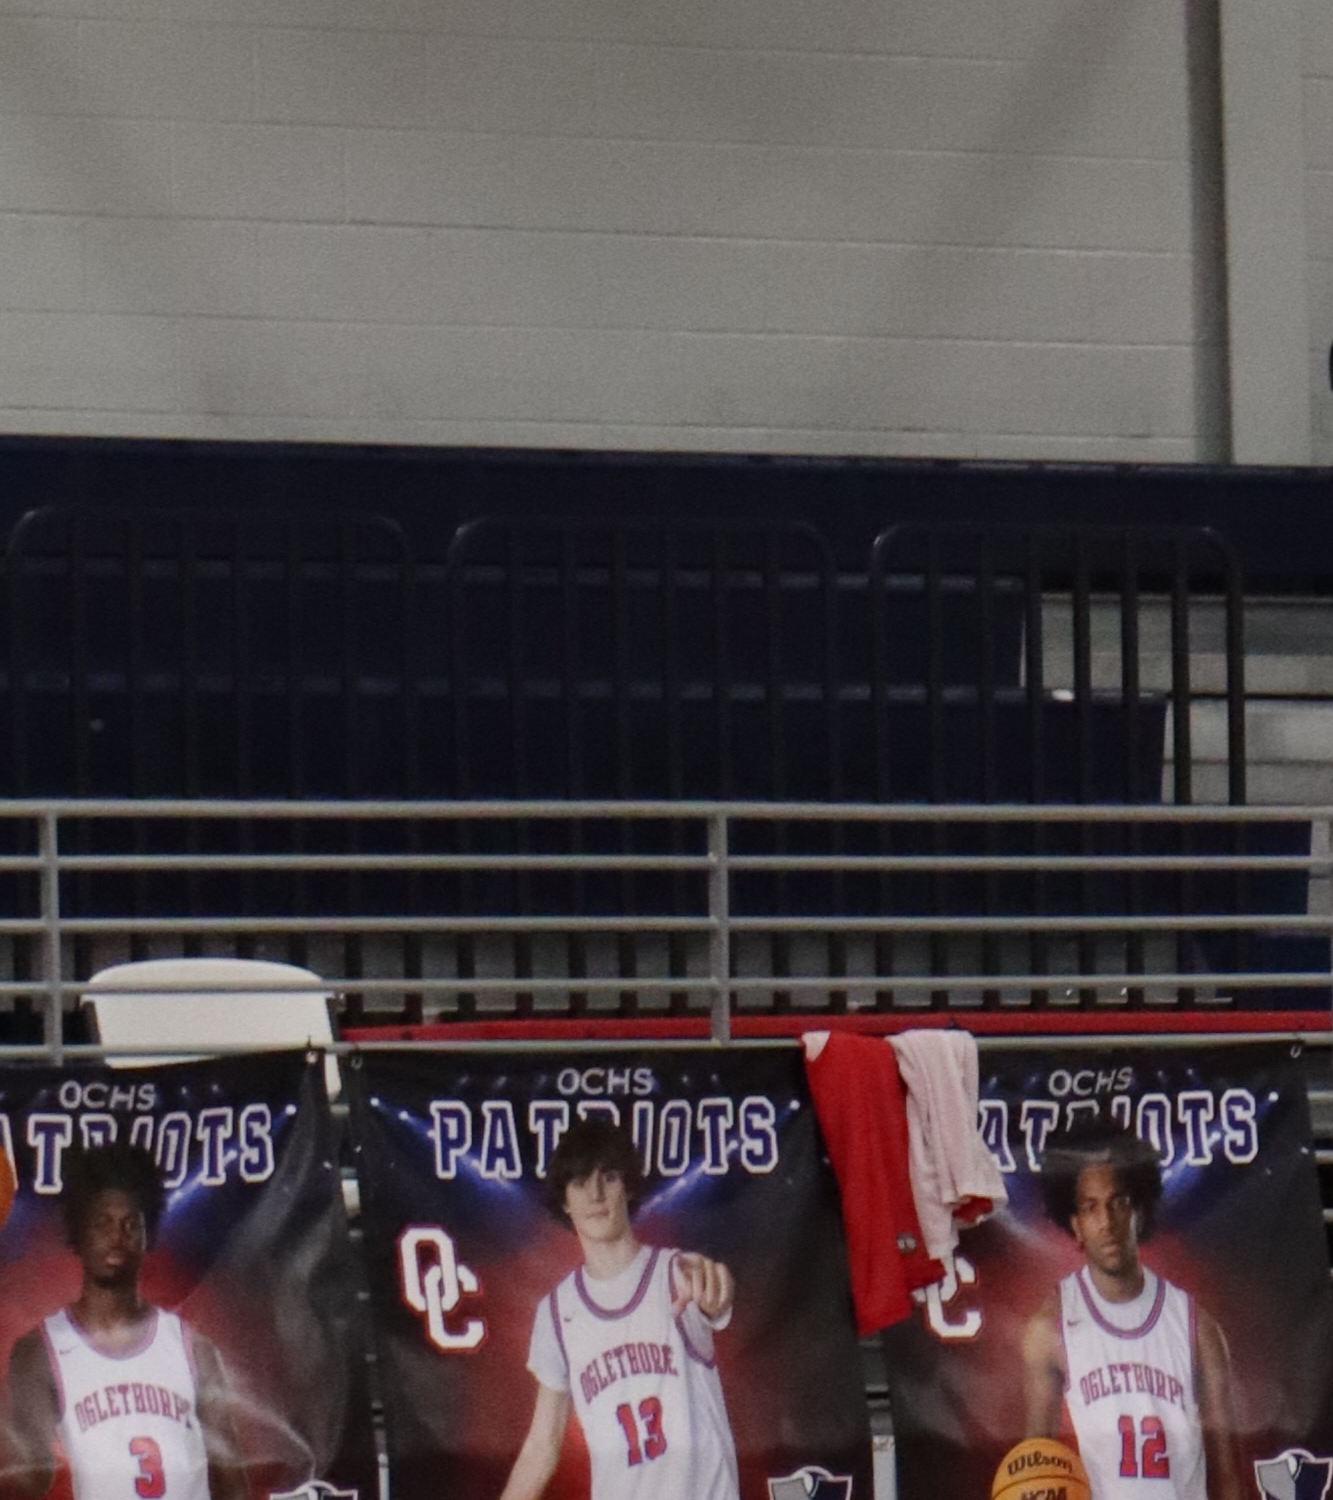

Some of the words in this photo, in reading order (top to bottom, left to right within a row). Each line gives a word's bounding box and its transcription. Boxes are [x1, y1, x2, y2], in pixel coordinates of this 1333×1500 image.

[59, 1079, 157, 1111] OCHS
[556, 1067, 655, 1096] OCHS
[1048, 1066, 1133, 1097] OCHS
[399, 1225, 487, 1351] OC
[616, 1396, 667, 1468] 13
[1118, 1414, 1170, 1479] 12
[129, 1436, 166, 1499] 3
[1007, 1450, 1072, 1476] Wilson
